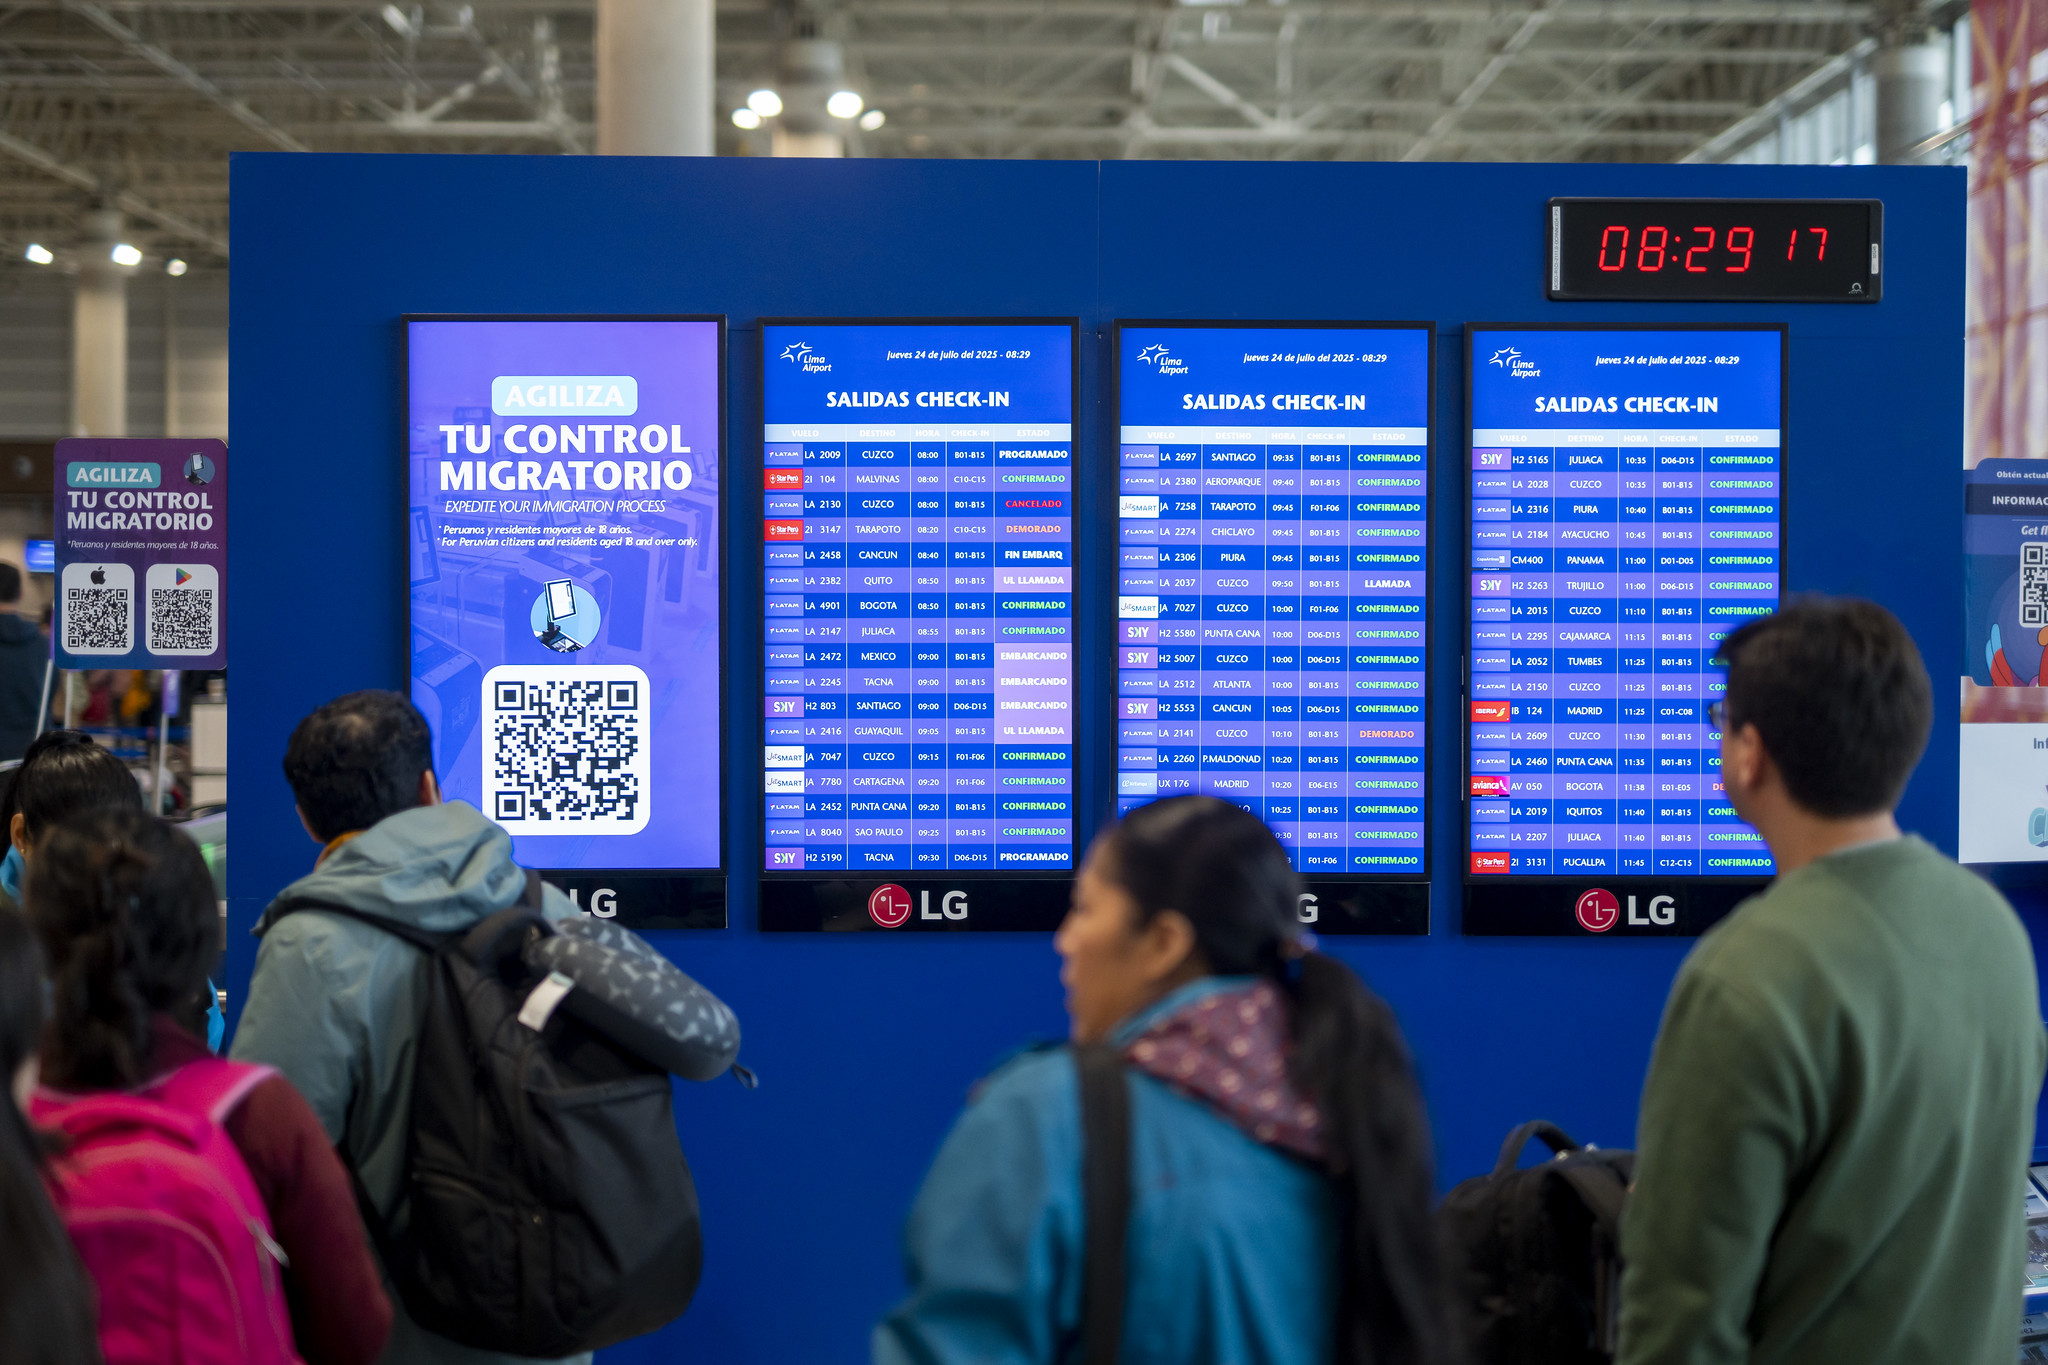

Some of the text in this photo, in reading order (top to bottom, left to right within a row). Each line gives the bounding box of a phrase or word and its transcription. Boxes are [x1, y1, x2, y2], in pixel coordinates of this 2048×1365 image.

[1598, 226, 1754, 272] 08:29
[1787, 228, 1828, 261] 17
[803, 354, 825, 363] Lima
[915, 351, 926, 359] 24
[928, 351, 938, 359] de
[939, 350, 959, 361] julio
[961, 350, 974, 358] del
[976, 351, 998, 359] 2025
[1006, 351, 1030, 359] 08:29
[1160, 356, 1182, 366] Lima
[802, 363, 832, 373] Airport
[1512, 359, 1534, 369] Lima
[1159, 365, 1189, 376] Airport
[1511, 368, 1541, 379] Airport
[505, 385, 624, 407] AGILIZA
[827, 392, 1009, 407] SALIDAS CHECK-IN
[1183, 394, 1365, 410] SALIDAS CHECK-IN
[1535, 397, 1718, 412] SALIDAS CHECK-IN
[439, 424, 691, 454] TU CONTROL
[792, 429, 1050, 438] VUELO DESTINO HORA CHECK-IN ESTADO
[805, 451, 815, 459] LA
[820, 451, 840, 459] 2009
[862, 451, 894, 459] CUZCO
[999, 450, 1068, 458] PROGRAMADO
[1513, 456, 1524, 464] H2
[1528, 456, 1548, 464] 5165
[1569, 456, 1603, 465] JULIACA
[1626, 457, 1646, 465] 10:35
[1661, 457, 1694, 465] D06-D15
[1710, 456, 1773, 464] CONFIRMADO
[75, 468, 152, 482] AGILIZA
[441, 460, 692, 491] MIGRATORIO
[1997, 471, 2021, 479] Obtén
[1160, 477, 1170, 485] LA
[1175, 478, 1196, 486] 2380
[1206, 478, 1261, 487] AEROPARQUE
[1273, 479, 1294, 487] 09:40
[1310, 479, 1340, 487] B01-B15
[1358, 478, 1420, 487] CONFIRMADO
[68, 491, 213, 509] TU CONTROL
[445, 499, 666, 512] EXPEDITE YOUR IMMIGRATION PROCESS
[68, 512, 213, 530] MIGRATORIO
[443, 524, 632, 538] Peruanos y residentes mayores de 18 años.
[804, 526, 813, 534] 2I
[820, 526, 841, 534] 3147
[855, 526, 901, 534] TARAPOTO
[1007, 525, 1061, 533] DEMORADO
[2021, 525, 2038, 535] Get
[105, 542, 110, 550] y
[111, 541, 145, 549] residentes
[147, 542, 177, 551] mayores
[179, 541, 188, 549] de
[191, 541, 198, 549] 18
[200, 541, 218, 549] años.
[441, 537, 697, 548] For Peruvian citizens and residents aged 18 and over only.
[1512, 556, 1773, 565] CM400 PANAMA 11:00 D01-D05 CONFIRMADO
[1160, 579, 1170, 587] LA
[1175, 578, 1195, 586] 2037
[1217, 579, 1249, 588] CUZCO
[1272, 580, 1293, 588] 09:50
[1365, 580, 1411, 588] LLAMADA
[806, 702, 817, 710] H2
[820, 702, 836, 710] 803
[857, 702, 901, 710] SANTIAGO
[918, 703, 939, 711] 09:00
[954, 703, 987, 711] D06-D15
[1001, 701, 1067, 709] EMBARCANDO
[1157, 704, 1170, 712] H2
[1174, 704, 1194, 712] 5553
[1213, 704, 1251, 712] CANCUN
[1307, 706, 1340, 714] D06-D15
[1356, 705, 1419, 713] CONFIRMADO
[1511, 758, 1522, 766] LA
[1526, 758, 1547, 766] 2460
[1557, 758, 1586, 766] PUNTA
[1588, 758, 1613, 766] CANA
[1625, 759, 1644, 767] 11:35
[1661, 759, 1691, 767] B01-B15
[805, 777, 814, 787] JA
[821, 777, 841, 785] 7780
[853, 777, 905, 785] CARTAGENA
[1003, 777, 1065, 785] CONFIRMADO
[1511, 858, 1518, 866] 2I
[1527, 858, 1545, 866] 3131
[1564, 858, 1605, 866] PUCALLPA
[1708, 859, 1771, 867] CONFIRMADO
[568, 889, 616, 920] LG
[921, 891, 967, 920] LG
[1298, 894, 1318, 923] G
[1628, 895, 1675, 925] LG
